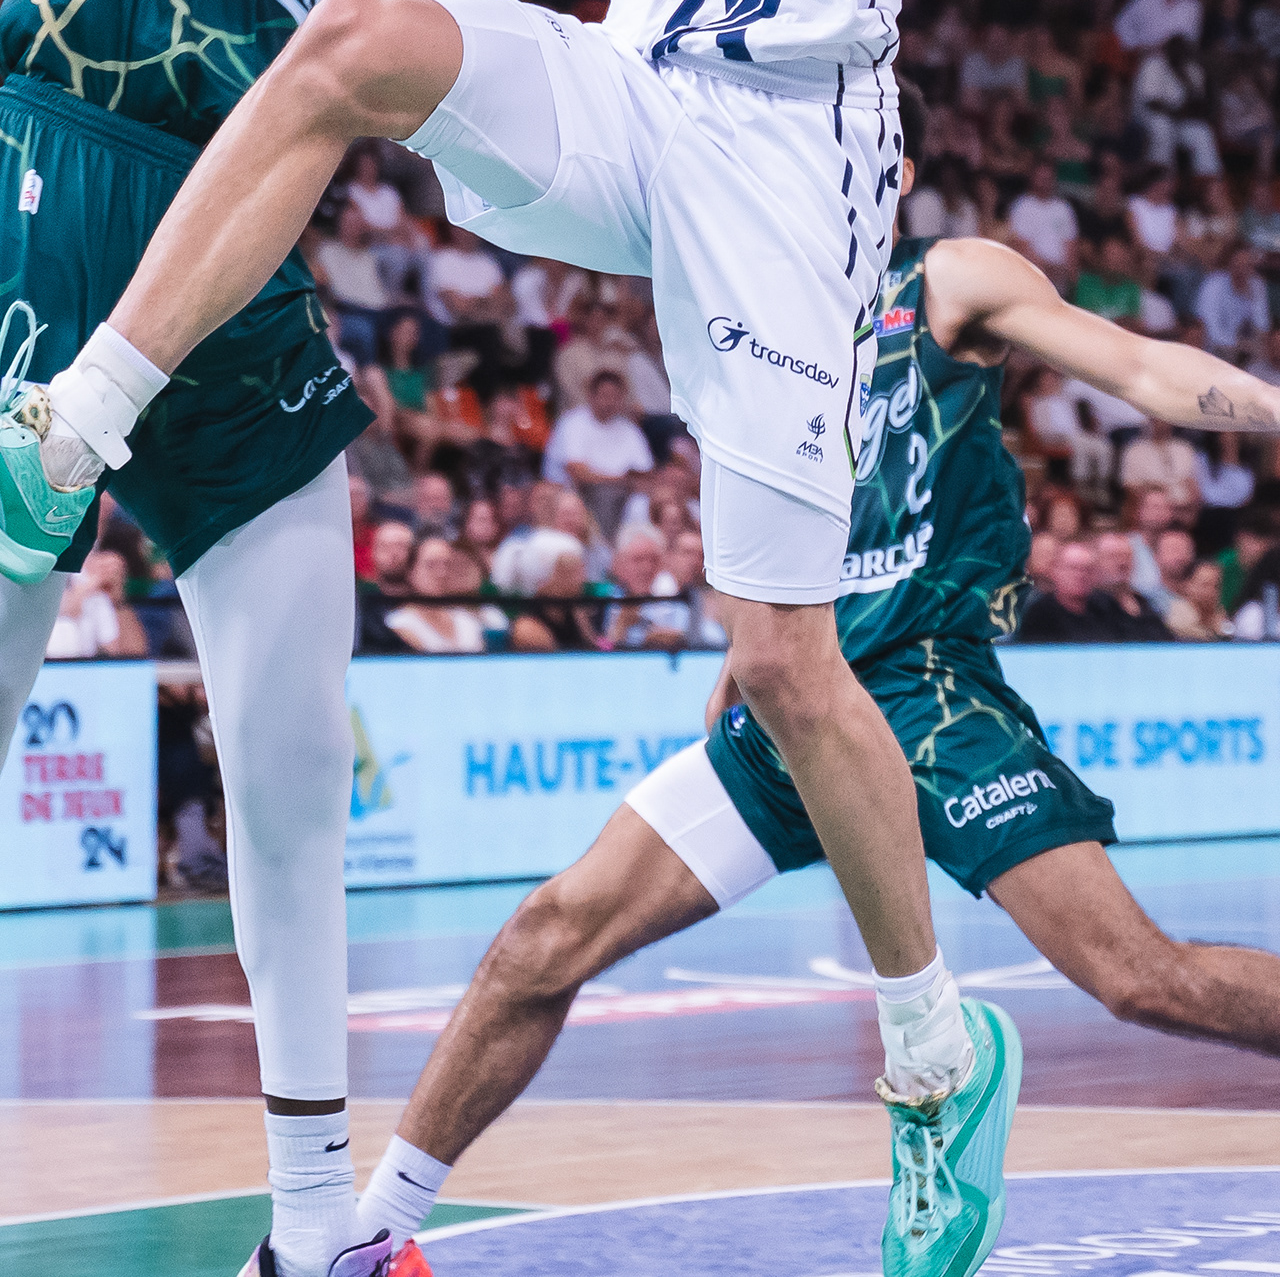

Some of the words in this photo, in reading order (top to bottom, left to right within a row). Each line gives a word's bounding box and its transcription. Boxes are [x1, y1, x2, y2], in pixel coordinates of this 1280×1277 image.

[749, 338, 840, 389] transdev
[1078, 721, 1118, 769] DE
[1132, 717, 1265, 768] SPORTS
